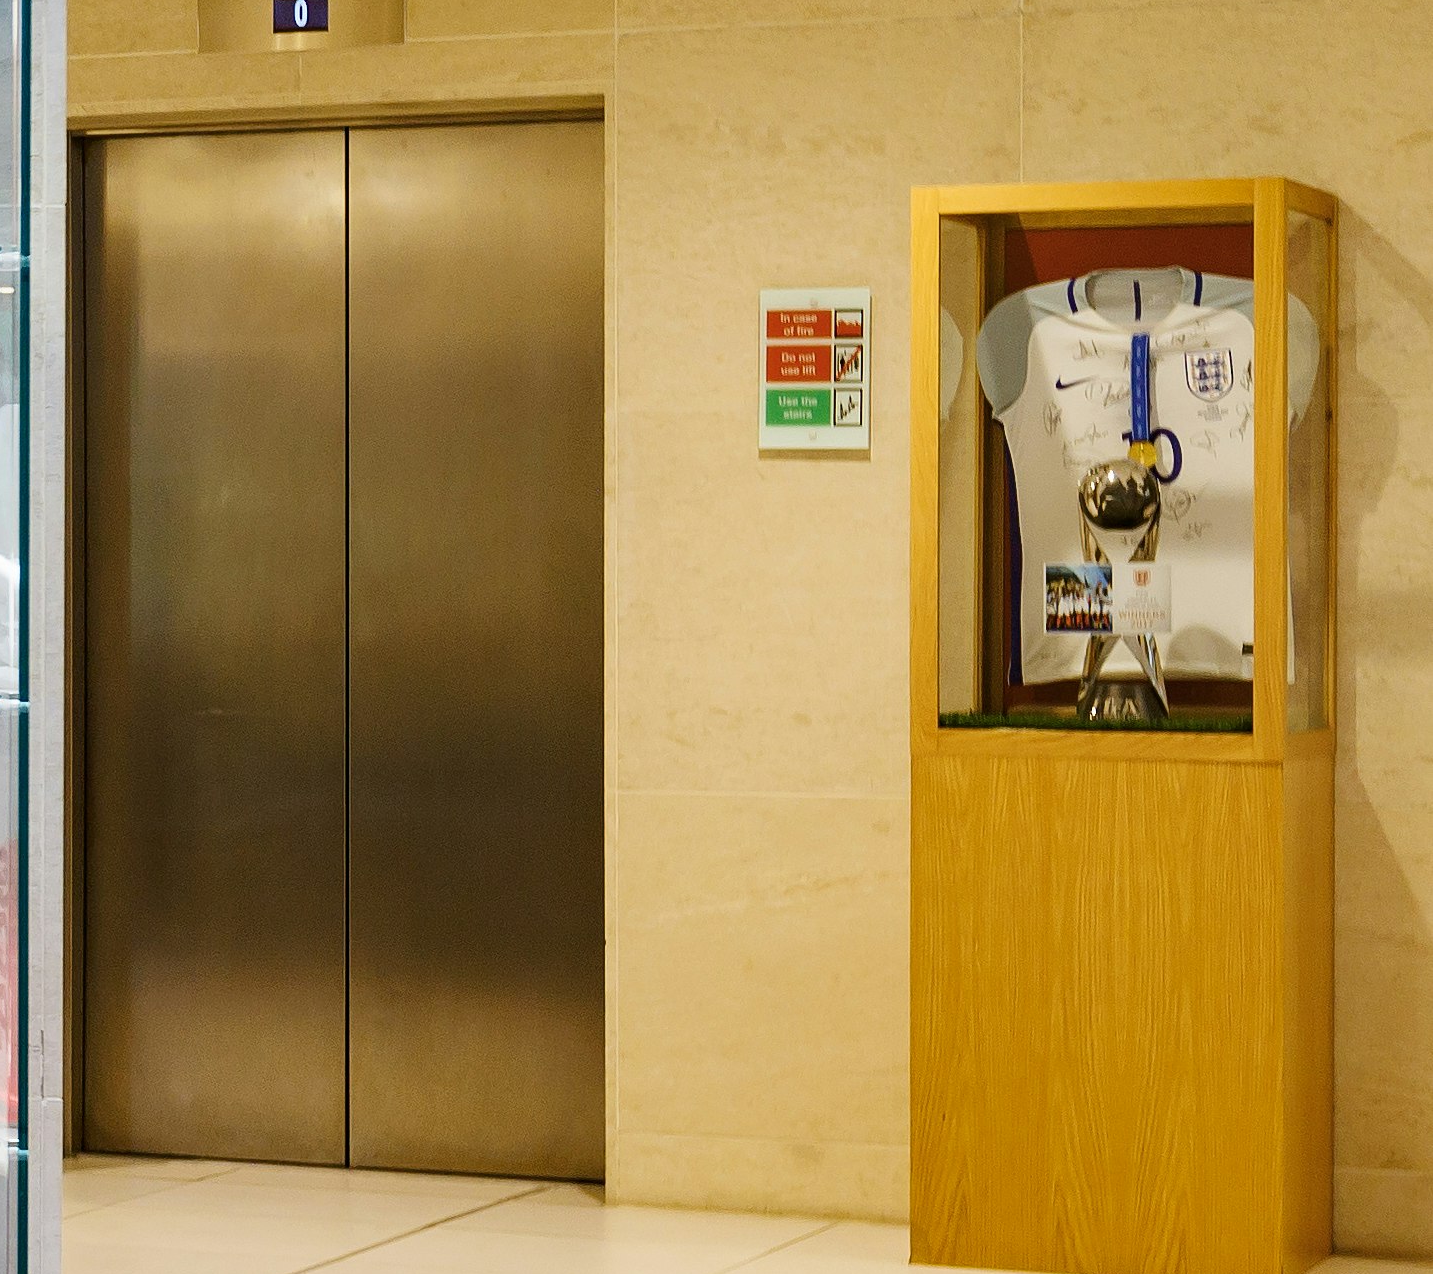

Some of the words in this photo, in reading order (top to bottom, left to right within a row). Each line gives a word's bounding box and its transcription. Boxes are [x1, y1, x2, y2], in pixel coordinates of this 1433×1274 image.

[780, 312, 790, 323] In
[793, 313, 817, 323] case
[783, 325, 794, 337] of
[797, 325, 814, 336] fire
[781, 352, 796, 363] Do
[799, 352, 816, 363] not
[781, 366, 799, 376] use
[802, 365, 816, 376] lift
[778, 396, 798, 407] Use
[801, 395, 818, 407] the
[783, 410, 812, 420] stairs
